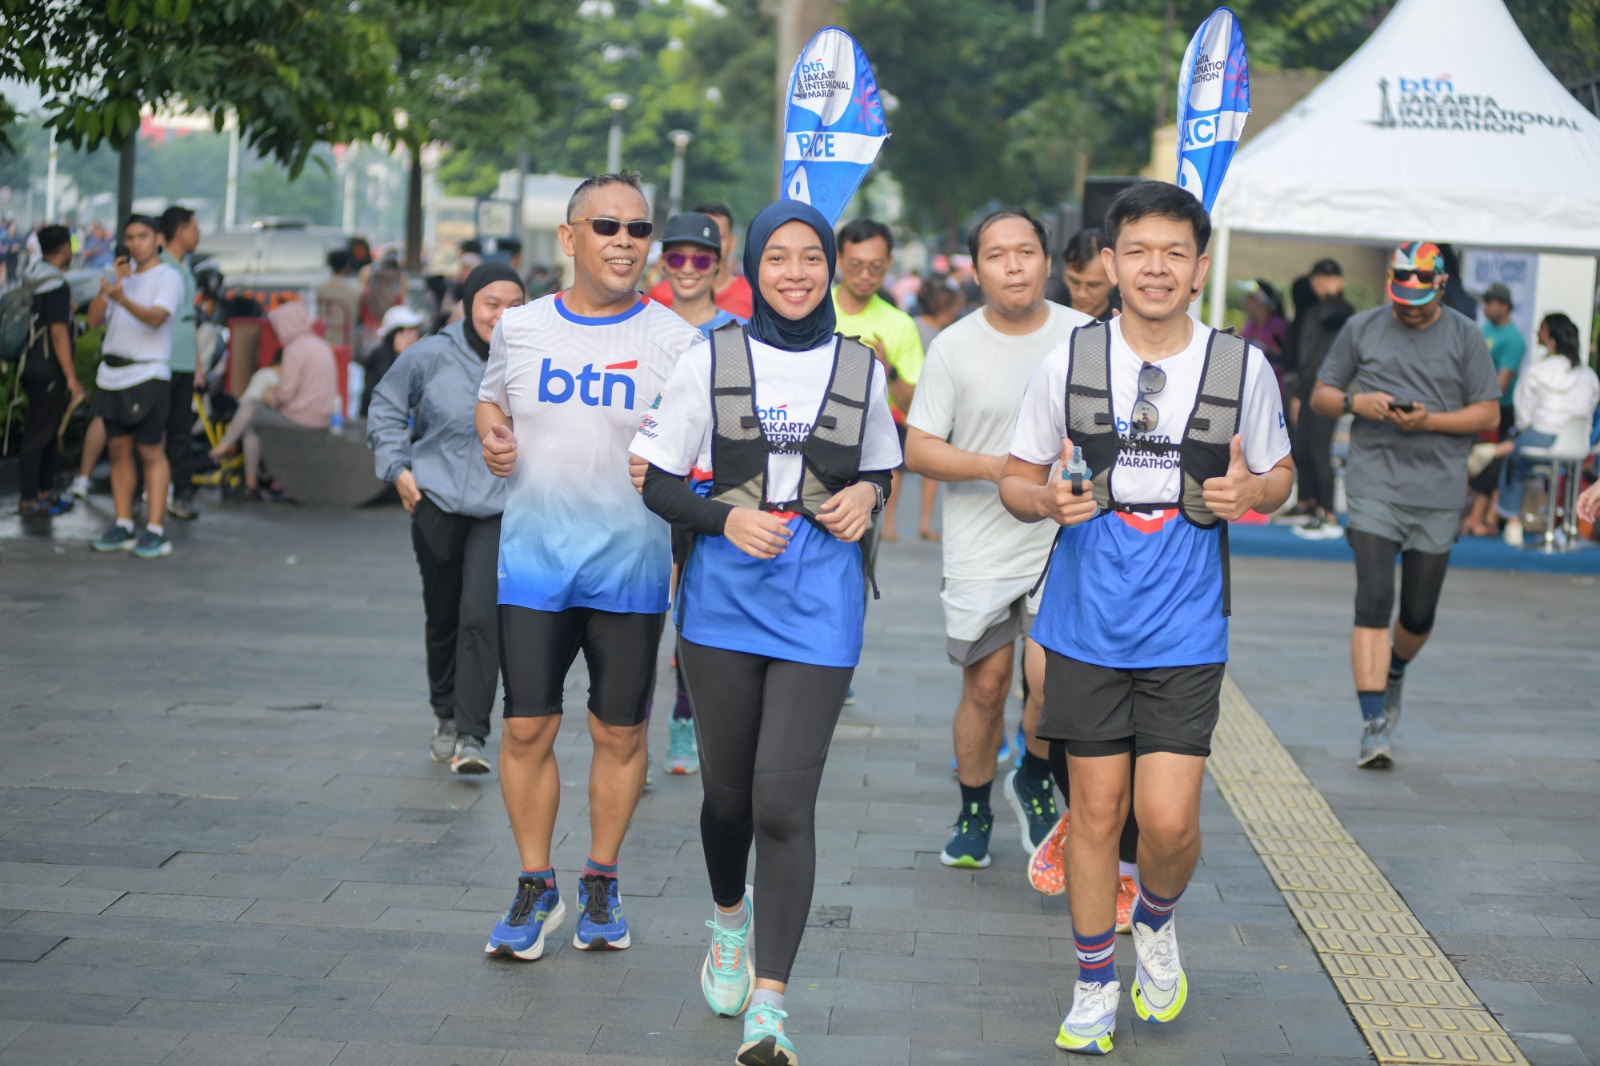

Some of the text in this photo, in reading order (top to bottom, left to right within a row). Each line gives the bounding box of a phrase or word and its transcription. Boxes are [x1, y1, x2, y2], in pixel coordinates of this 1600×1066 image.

[1398, 73, 1454, 93] btn
[1400, 93, 1499, 109] JAKARTA
[1398, 107, 1584, 132] INTERNATIONAL
[1401, 119, 1526, 136] MARATHON
[796, 133, 836, 157] PACE
[538, 358, 638, 410] btn
[756, 404, 787, 420] btn
[761, 422, 812, 433] AKARTA
